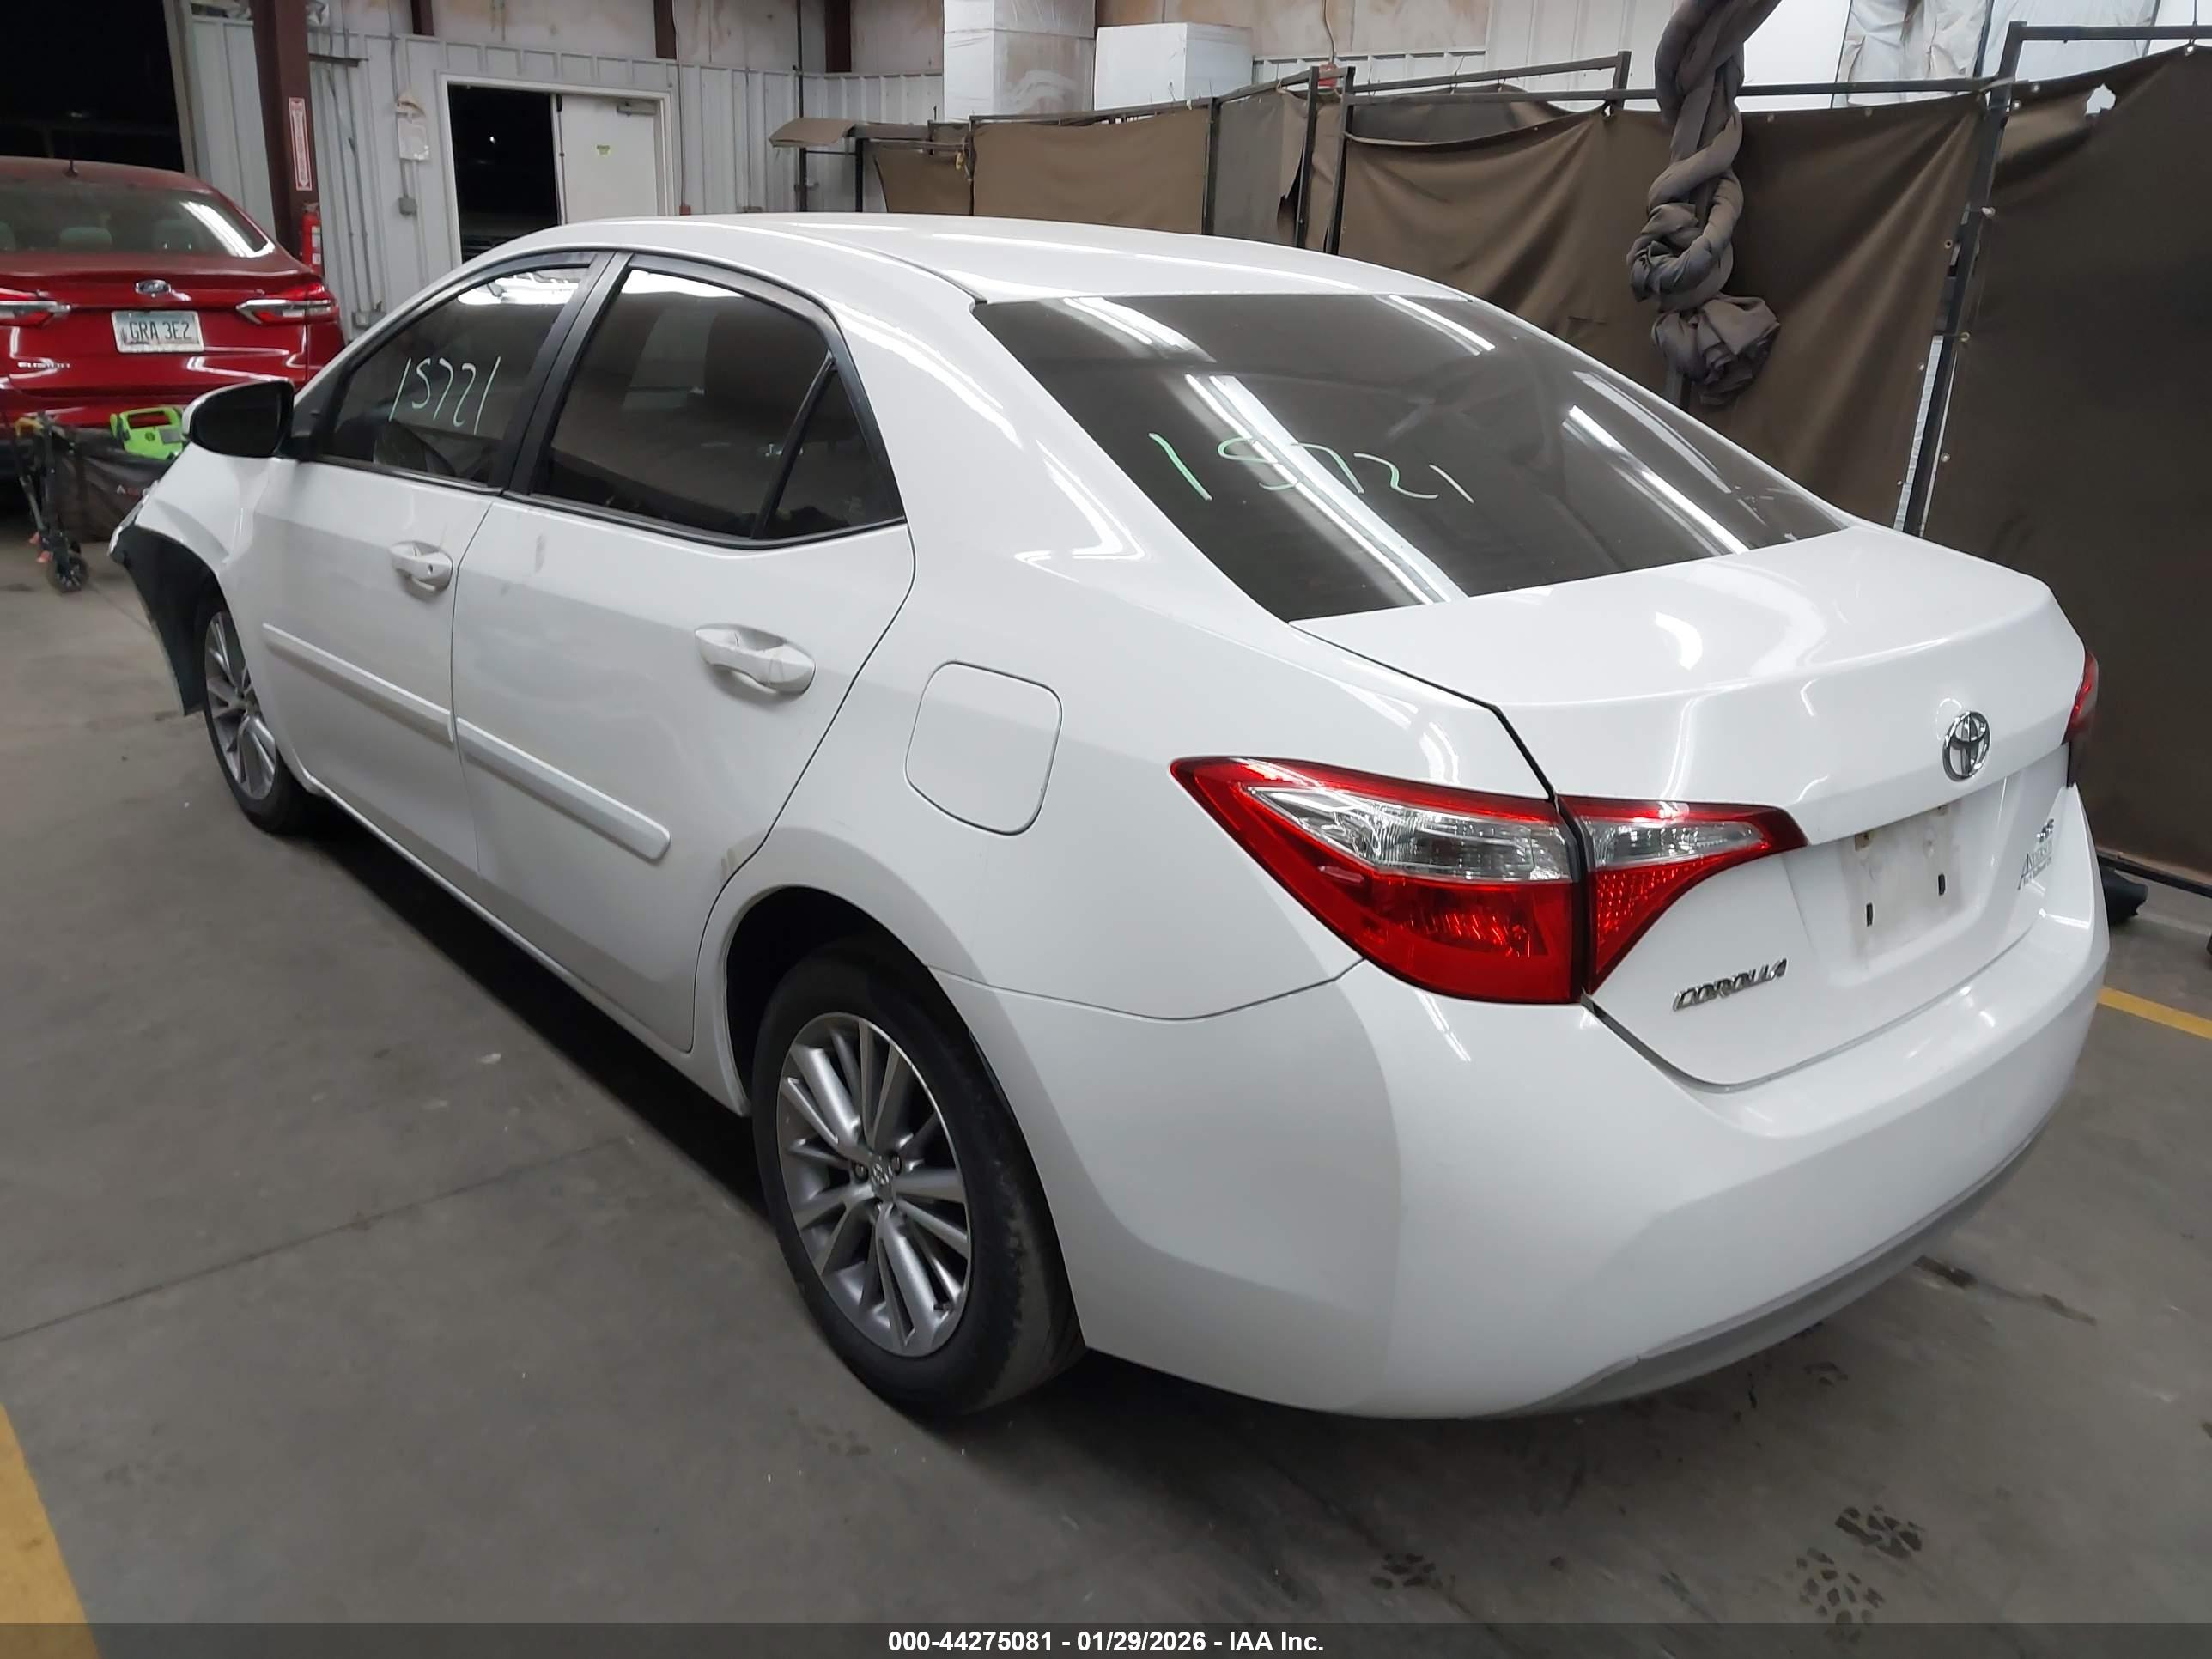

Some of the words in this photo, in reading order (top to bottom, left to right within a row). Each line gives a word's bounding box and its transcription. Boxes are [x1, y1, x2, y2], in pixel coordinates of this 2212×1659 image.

[129, 321, 159, 340] GRA
[162, 321, 192, 340] 3E2
[389, 356, 501, 435] 15721
[1148, 432, 1474, 504] 15721
[1673, 958, 1787, 1012] COROLLA
